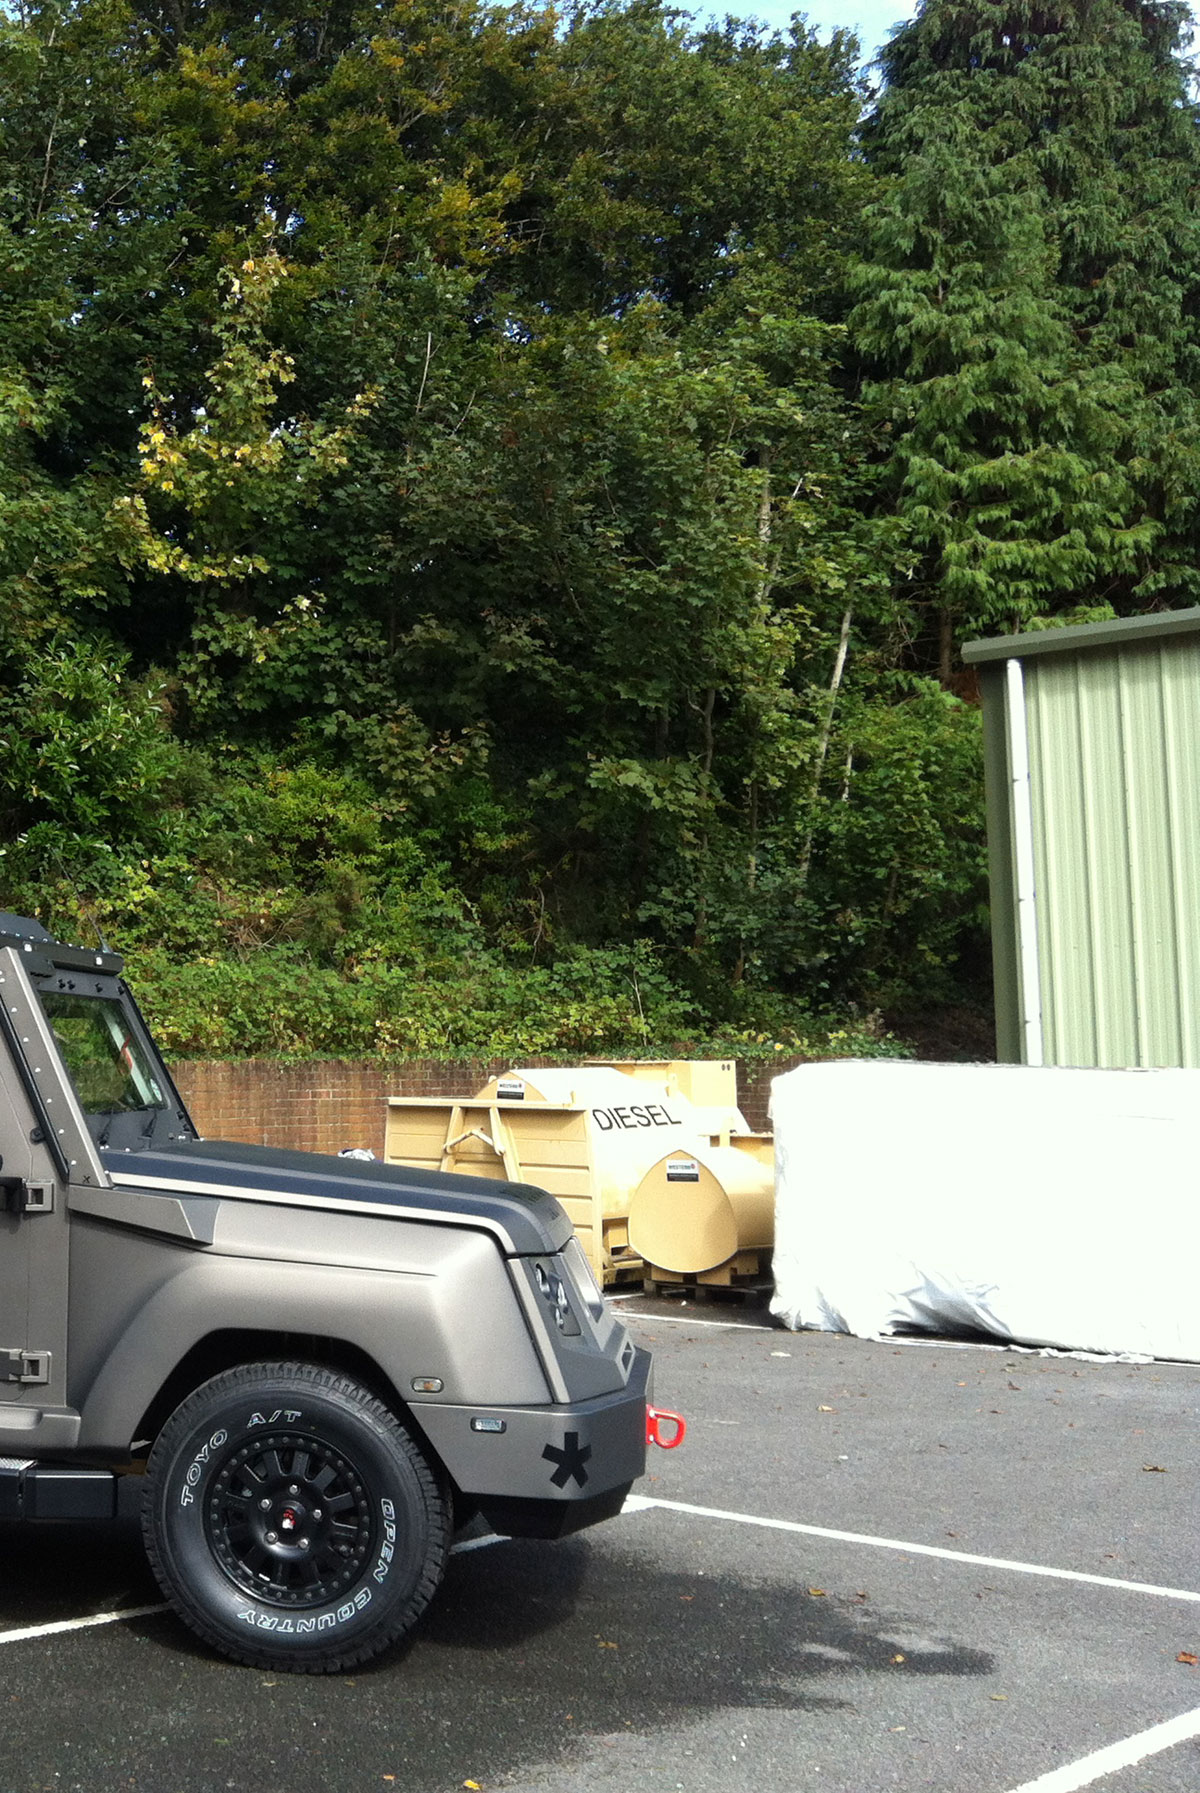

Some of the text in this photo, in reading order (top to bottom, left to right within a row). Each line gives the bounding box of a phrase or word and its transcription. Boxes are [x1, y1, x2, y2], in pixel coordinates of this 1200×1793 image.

[592, 1104, 682, 1131] DIESEL
[181, 1410, 302, 1507] TOYO A/T
[237, 1498, 396, 1633] OPEN COUNTRY
